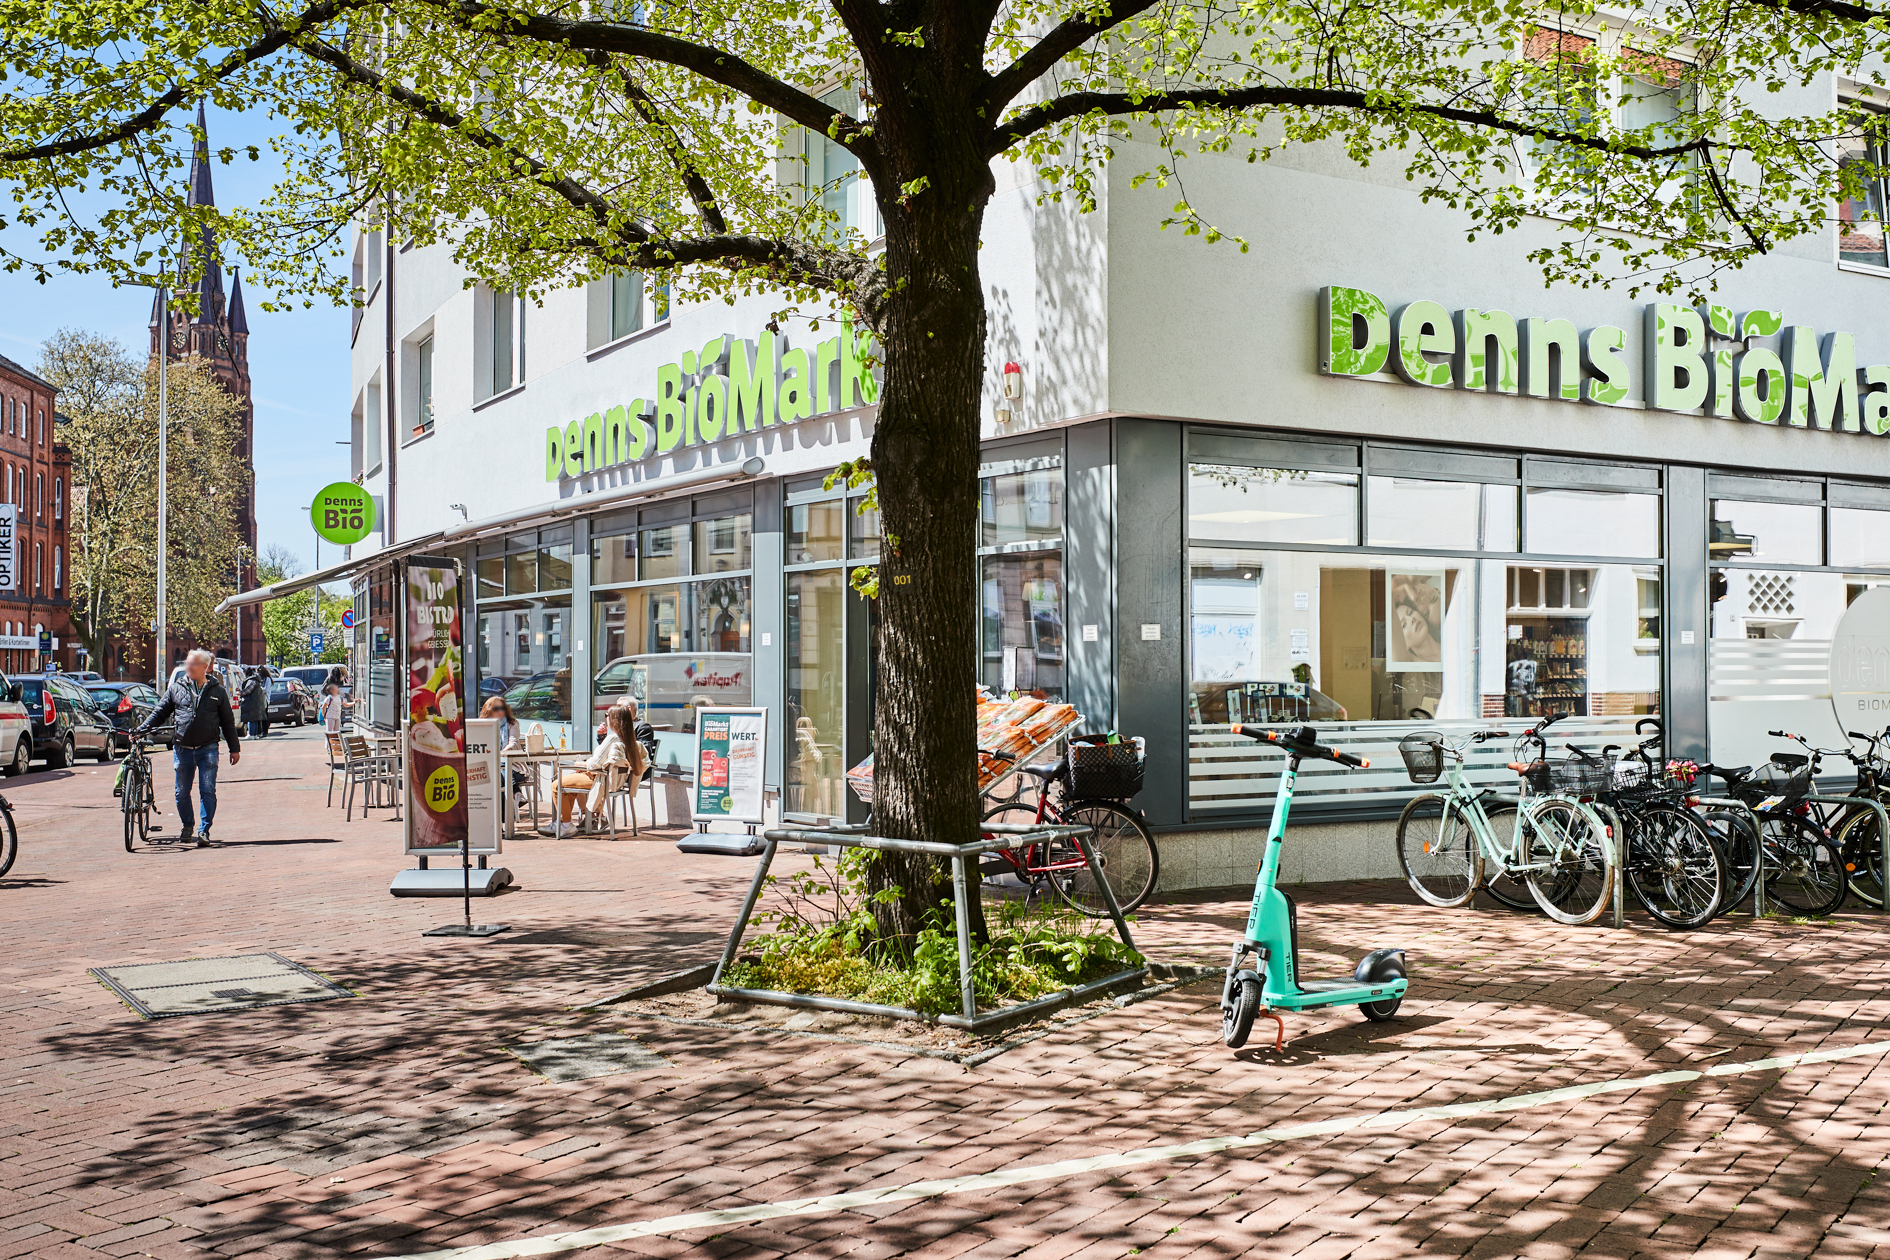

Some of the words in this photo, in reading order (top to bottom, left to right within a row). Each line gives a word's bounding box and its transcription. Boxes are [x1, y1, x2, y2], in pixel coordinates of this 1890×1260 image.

[1321, 285, 1631, 406] Denns
[546, 398, 654, 482] Denns
[657, 302, 880, 453] BioMark
[324, 497, 363, 506] Denns
[324, 508, 364, 529] Bio
[0, 517, 11, 586] OPTIKER
[894, 575, 911, 585] 001
[426, 582, 445, 600] BIO
[416, 605, 455, 624] BISTRO
[704, 731, 728, 741] PREIS
[466, 743, 488, 754] ERT
[466, 766, 486, 775] ERHAFT
[467, 773, 488, 781] NSTIG
[432, 784, 456, 802] Bio
[1249, 891, 1262, 929] TIER
[1285, 951, 1293, 983] TIER
